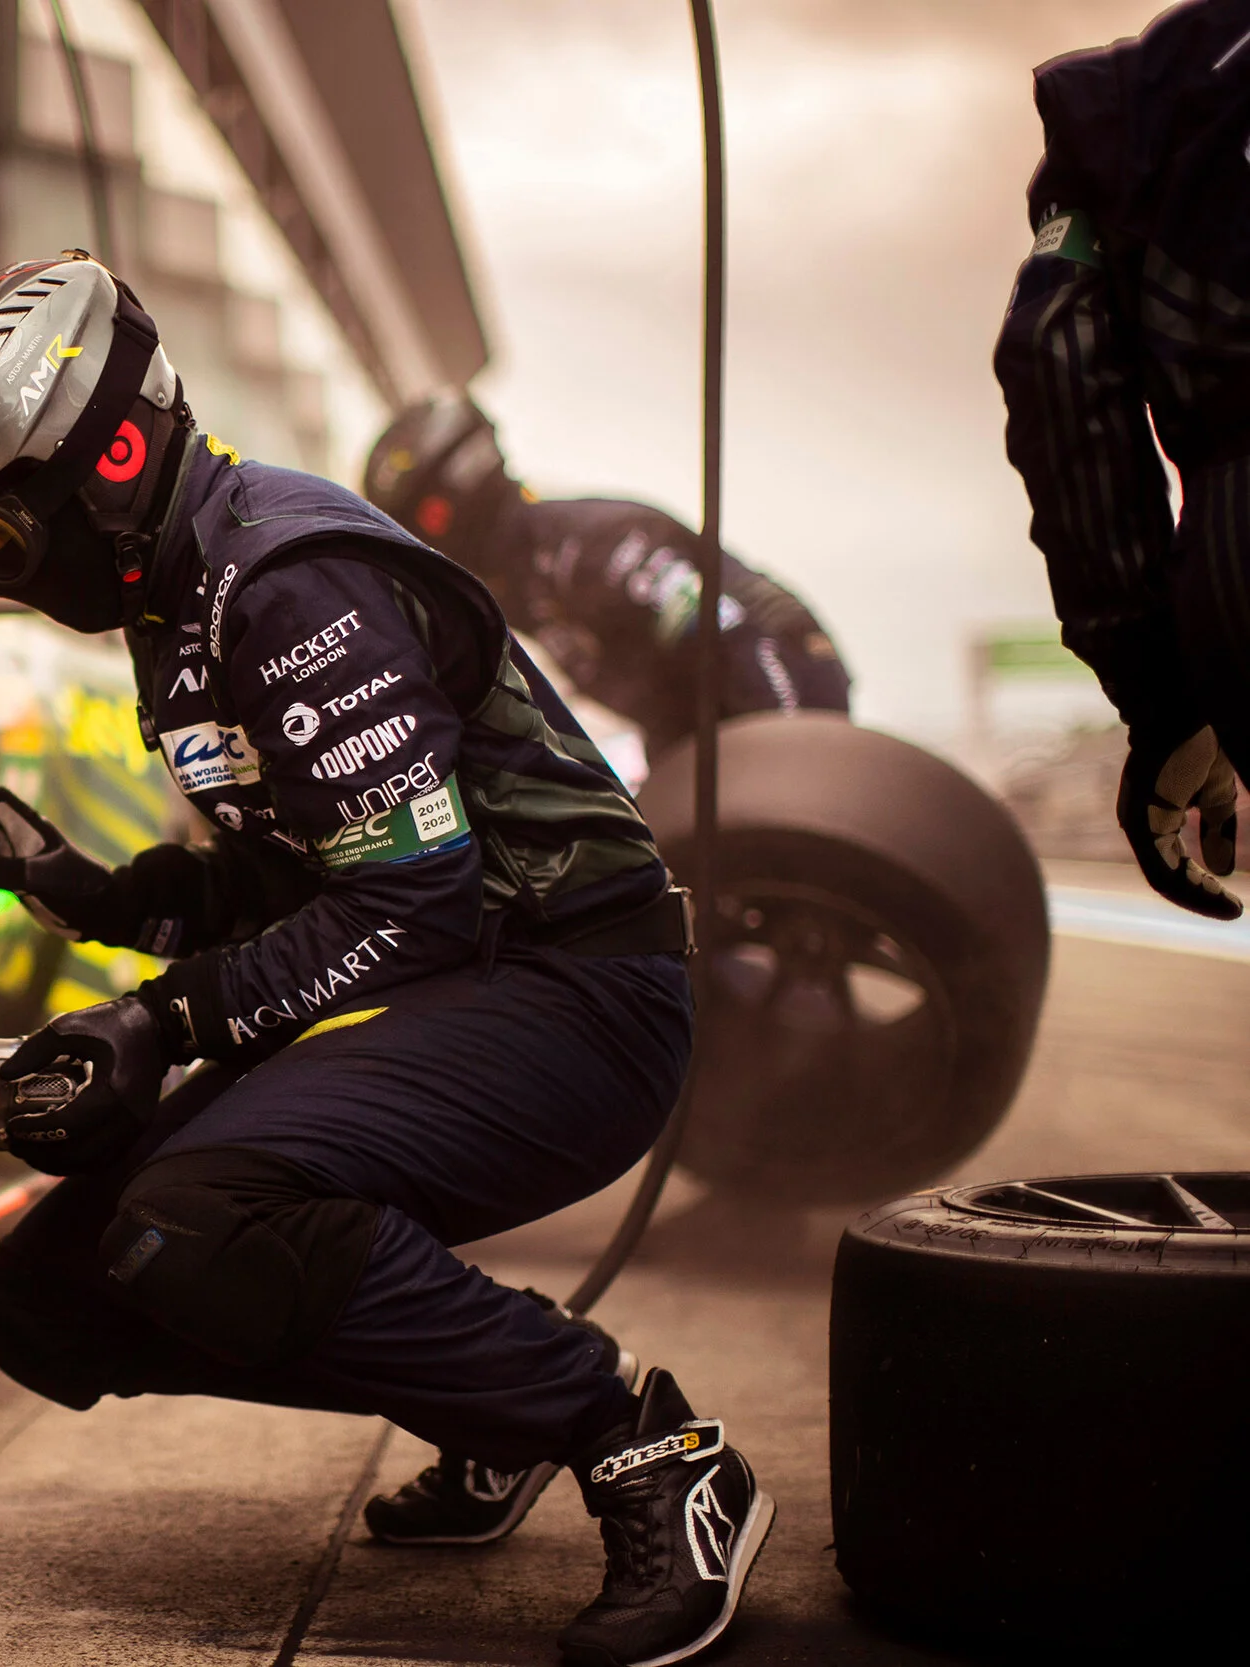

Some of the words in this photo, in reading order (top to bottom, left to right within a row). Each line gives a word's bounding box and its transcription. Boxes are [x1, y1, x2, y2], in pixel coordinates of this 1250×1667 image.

[1035, 236, 1059, 250] 020
[6, 358, 24, 385] ASTON
[22, 334, 43, 364] MARTIN
[19, 333, 84, 416] AMR
[210, 563, 239, 662] sparco
[178, 643, 203, 657] ASTO
[258, 610, 363, 686] HACKETT
[291, 645, 348, 684] LONDON
[321, 670, 403, 718] TOTAL
[320, 715, 408, 780] DUPONT
[182, 773, 238, 791] CHAMPIONS
[409, 778, 441, 801] WORKS
[417, 798, 450, 819] 2019
[421, 812, 453, 832] 2020
[345, 838, 395, 857] ENDURANCE
[590, 1433, 700, 1485] alpinestas
